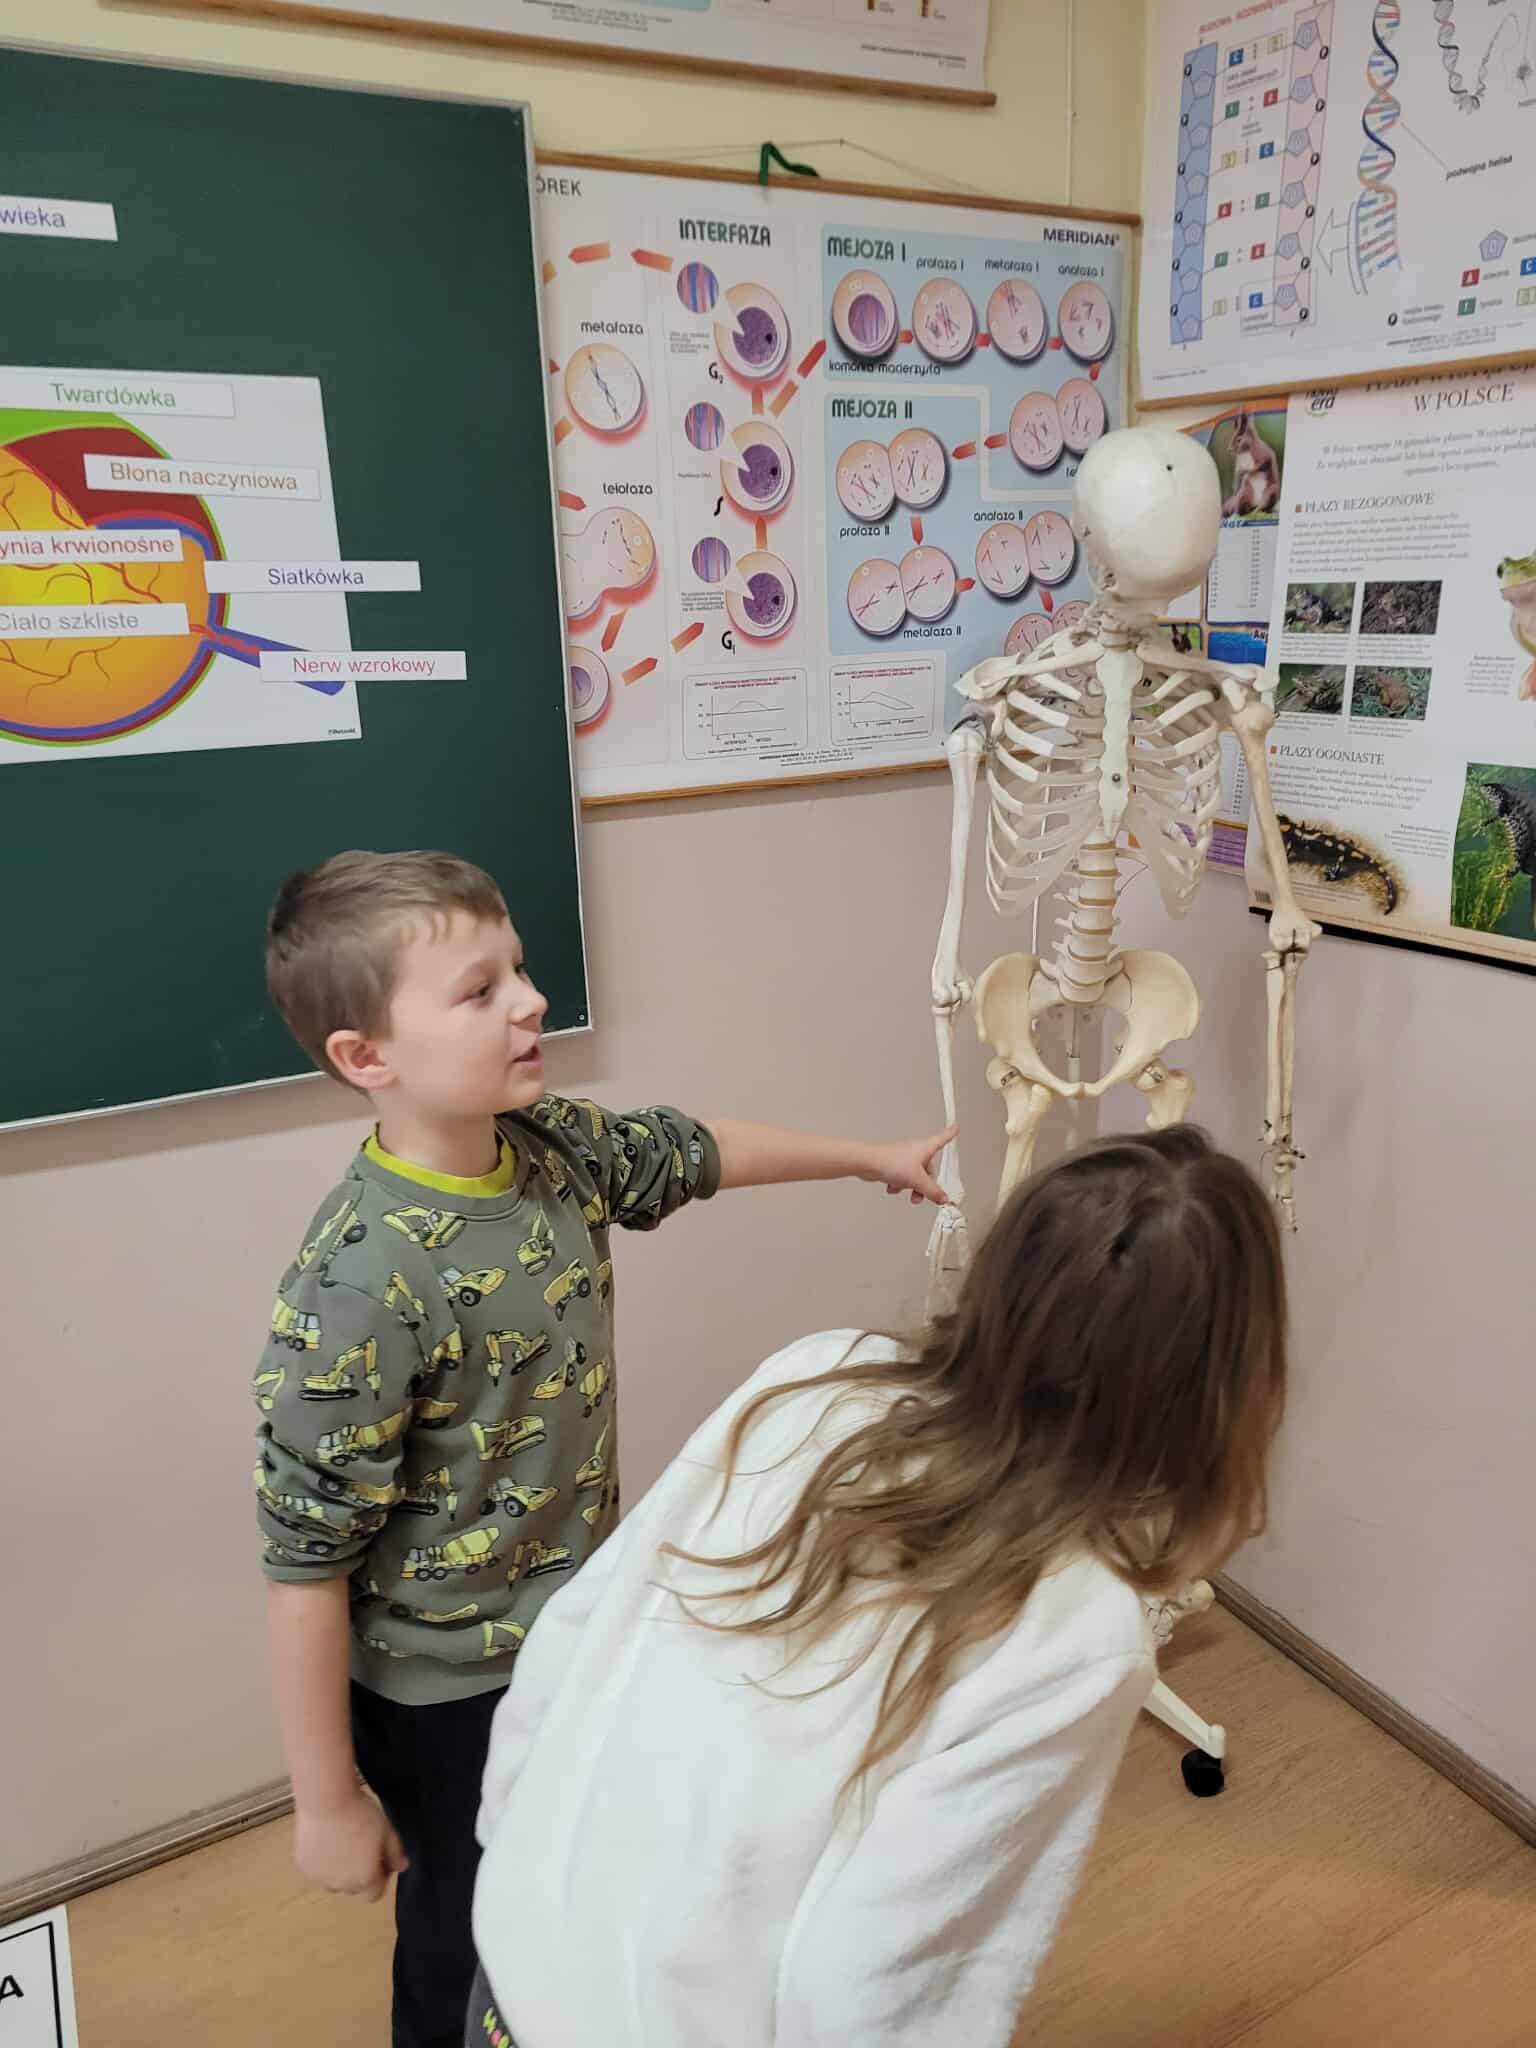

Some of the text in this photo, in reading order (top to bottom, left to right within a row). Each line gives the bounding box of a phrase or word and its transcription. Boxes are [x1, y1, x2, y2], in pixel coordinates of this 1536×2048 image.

[0, 205, 66, 228] wieka
[679, 218, 771, 247] INTERFAZA
[827, 235, 895, 261] MEJOZA
[580, 320, 644, 336] metafaza
[51, 382, 177, 407] Twardówka
[1414, 382, 1515, 412] W POLSCE
[831, 397, 913, 420] MEJOZA II
[110, 461, 298, 492] Błona naczyniowa
[839, 526, 881, 539] profaza
[51, 536, 175, 554] krwionośne
[268, 567, 364, 585] Siatkówka
[59, 612, 139, 631] szkliste
[903, 627, 953, 640] metafaza
[293, 656, 436, 676] Nerw wzrokowy
[1315, 747, 1386, 767] OGONIASTE
